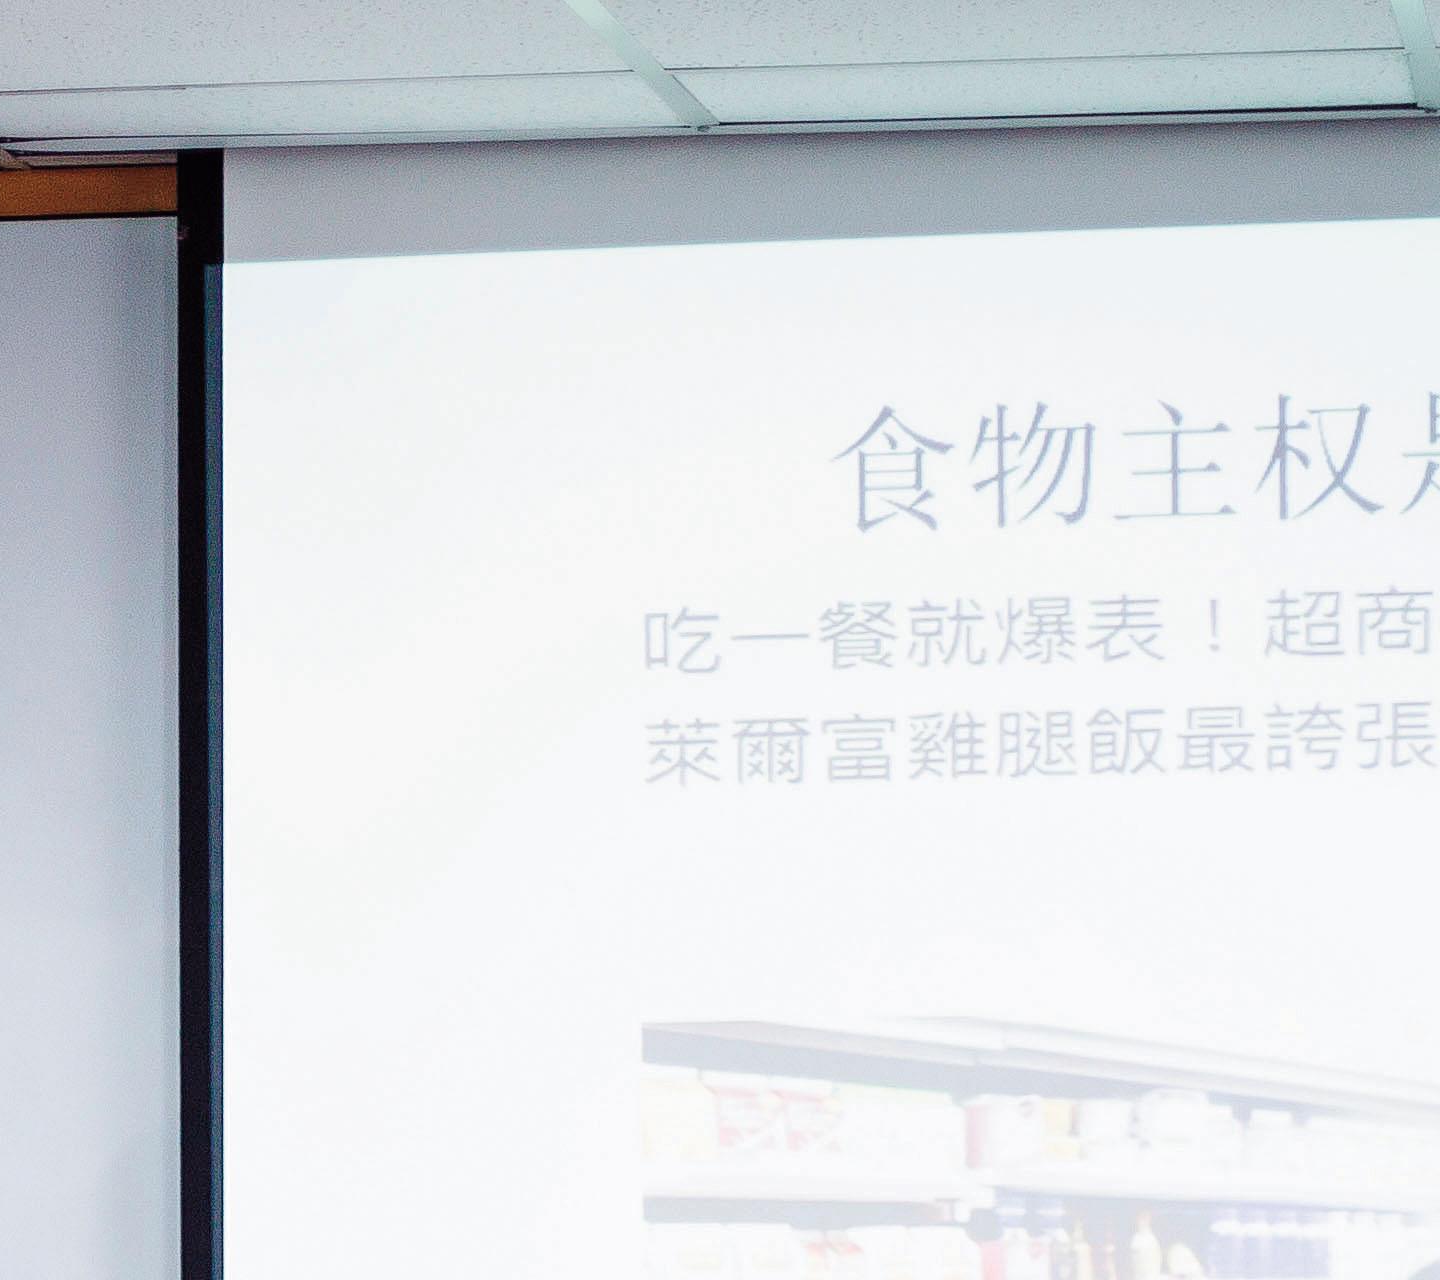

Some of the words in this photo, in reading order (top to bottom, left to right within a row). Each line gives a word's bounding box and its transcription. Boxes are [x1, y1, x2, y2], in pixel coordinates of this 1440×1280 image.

[643, 701, 1439, 786] 萊爾富雞腿飯最誇張
